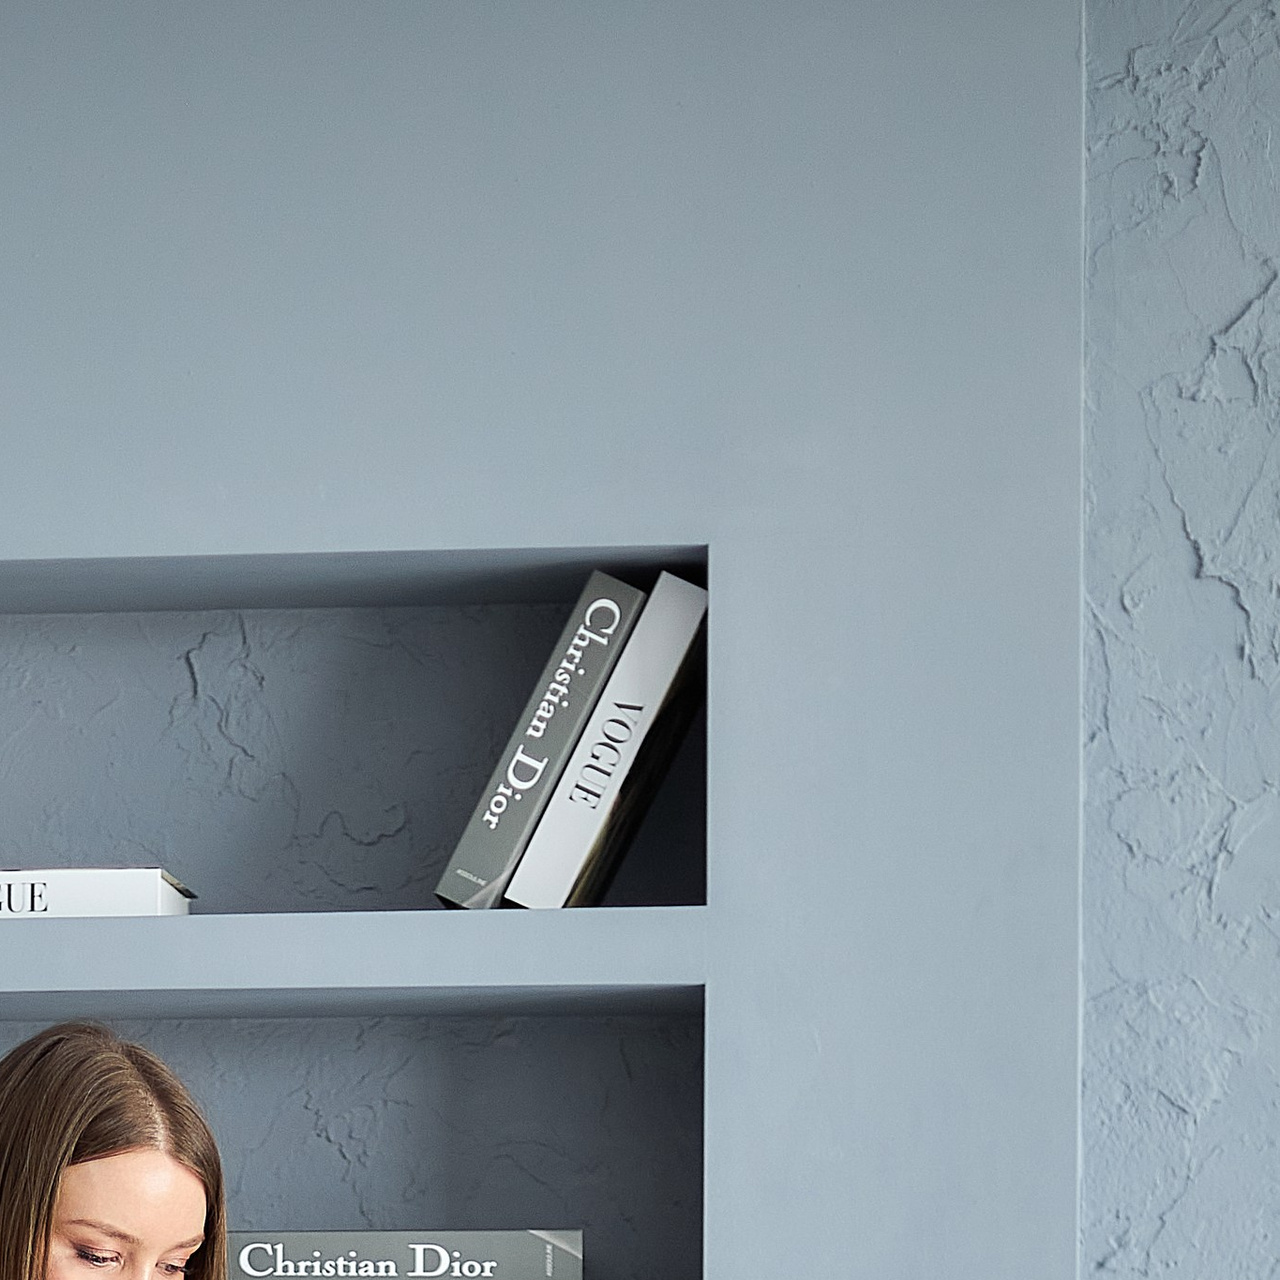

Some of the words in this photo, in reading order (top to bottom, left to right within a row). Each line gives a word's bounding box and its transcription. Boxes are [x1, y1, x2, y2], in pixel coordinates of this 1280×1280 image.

[525, 598, 622, 739] Christian
[482, 744, 549, 831] Dior
[568, 701, 644, 810] VOGUE
[238, 1242, 399, 1278] Christian
[407, 1243, 498, 1277] Dior
